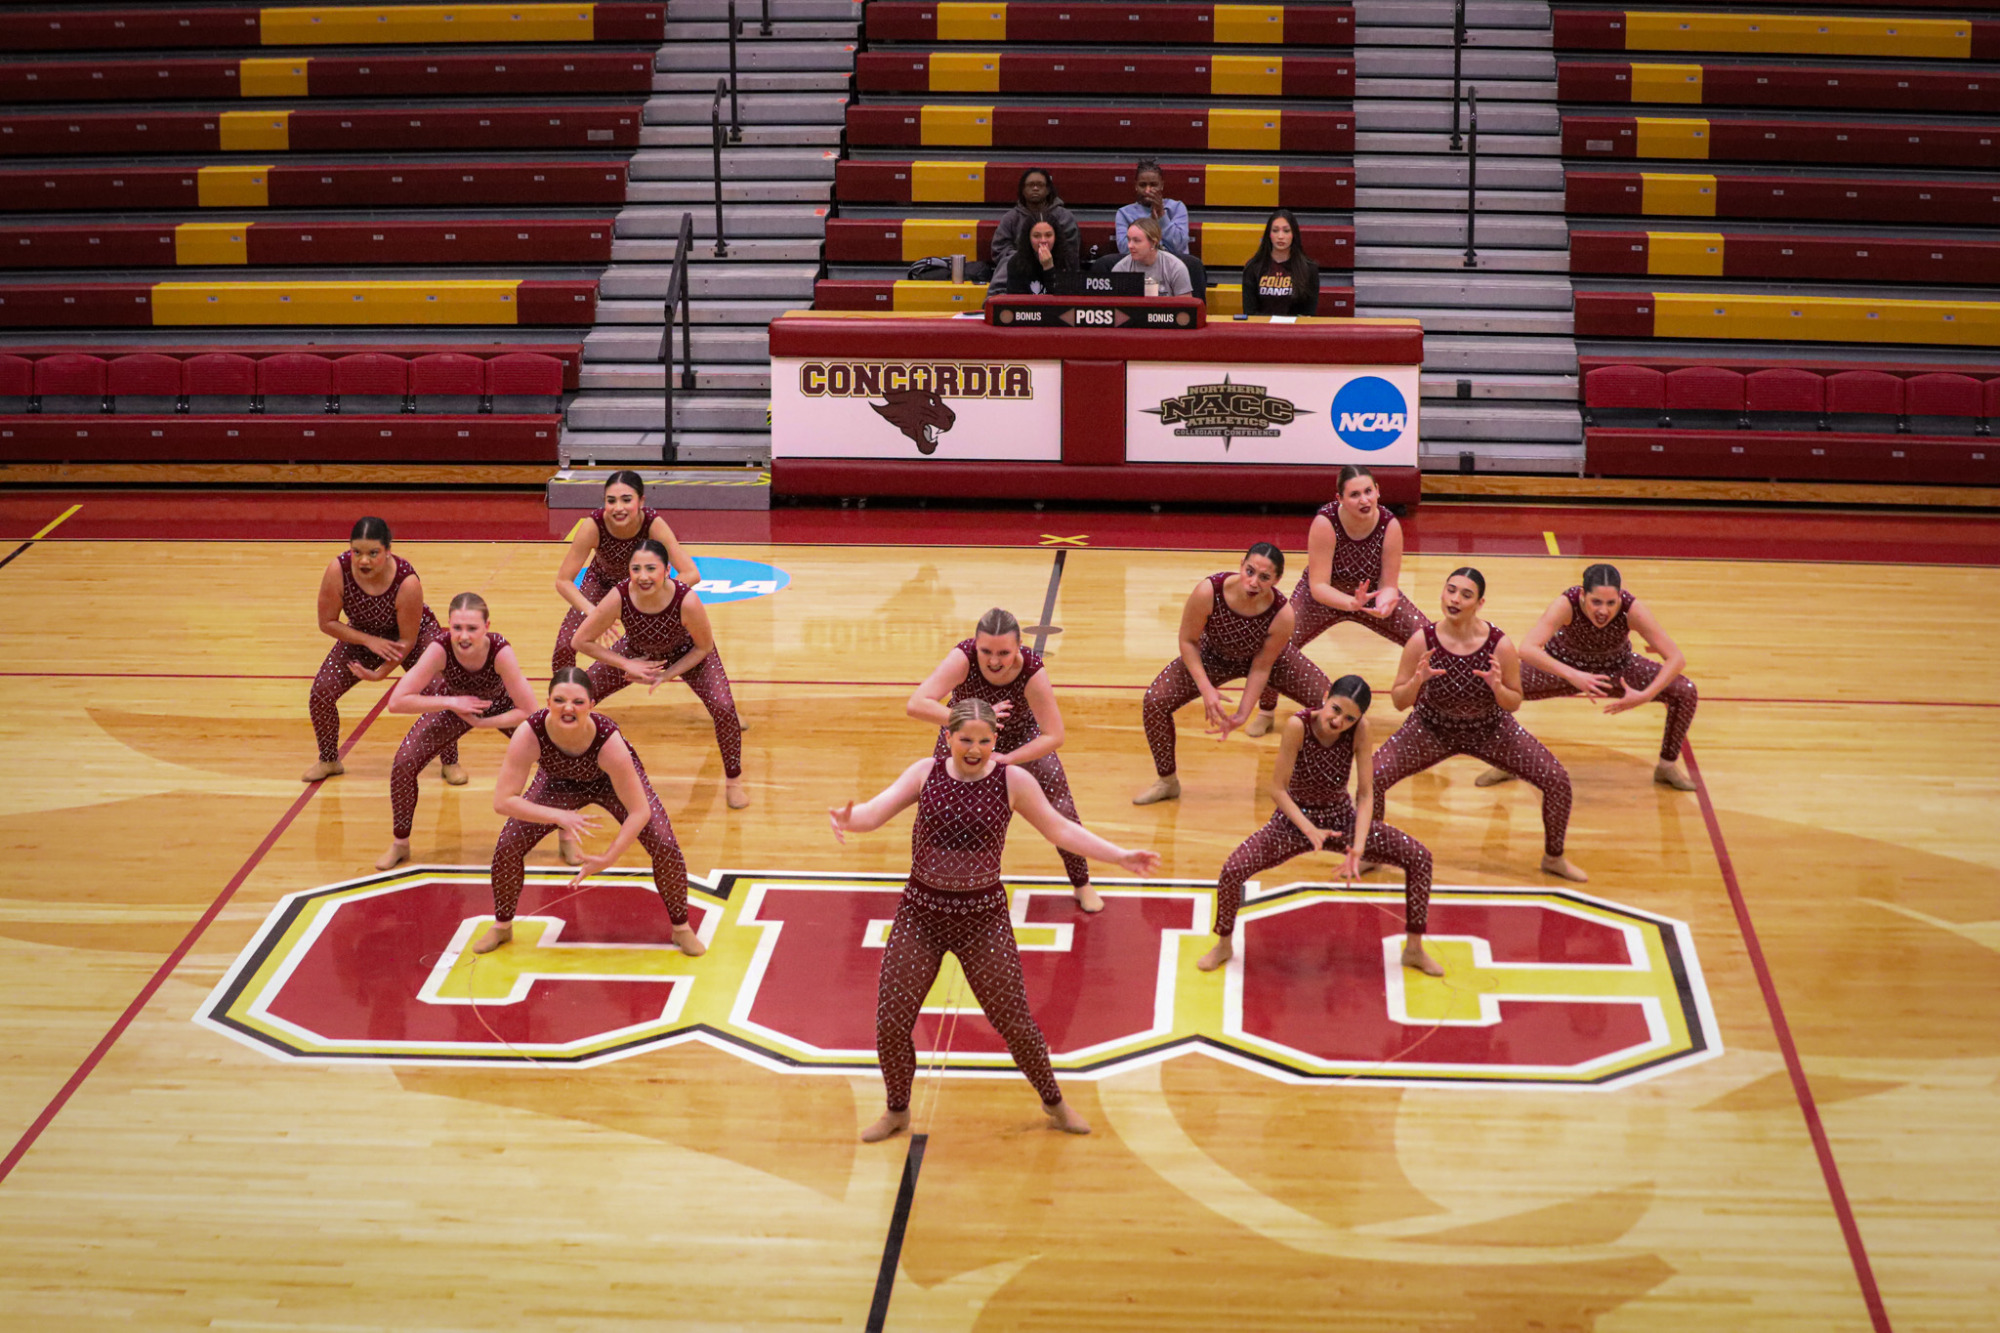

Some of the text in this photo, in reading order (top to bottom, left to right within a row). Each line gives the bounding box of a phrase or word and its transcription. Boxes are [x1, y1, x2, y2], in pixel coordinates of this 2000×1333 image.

[1086, 277, 1113, 291] POSS.
[1015, 309, 1174, 324] BONUS POSS BONUS
[800, 362, 1033, 399] CONCORDIA
[1189, 385, 1266, 395] NORTHERN
[1162, 394, 1294, 421] NACC
[1187, 416, 1269, 427] ATHLETICS
[1338, 412, 1405, 432] NCAA
[1175, 429, 1280, 437] COLLEGIATE CONFERENCE
